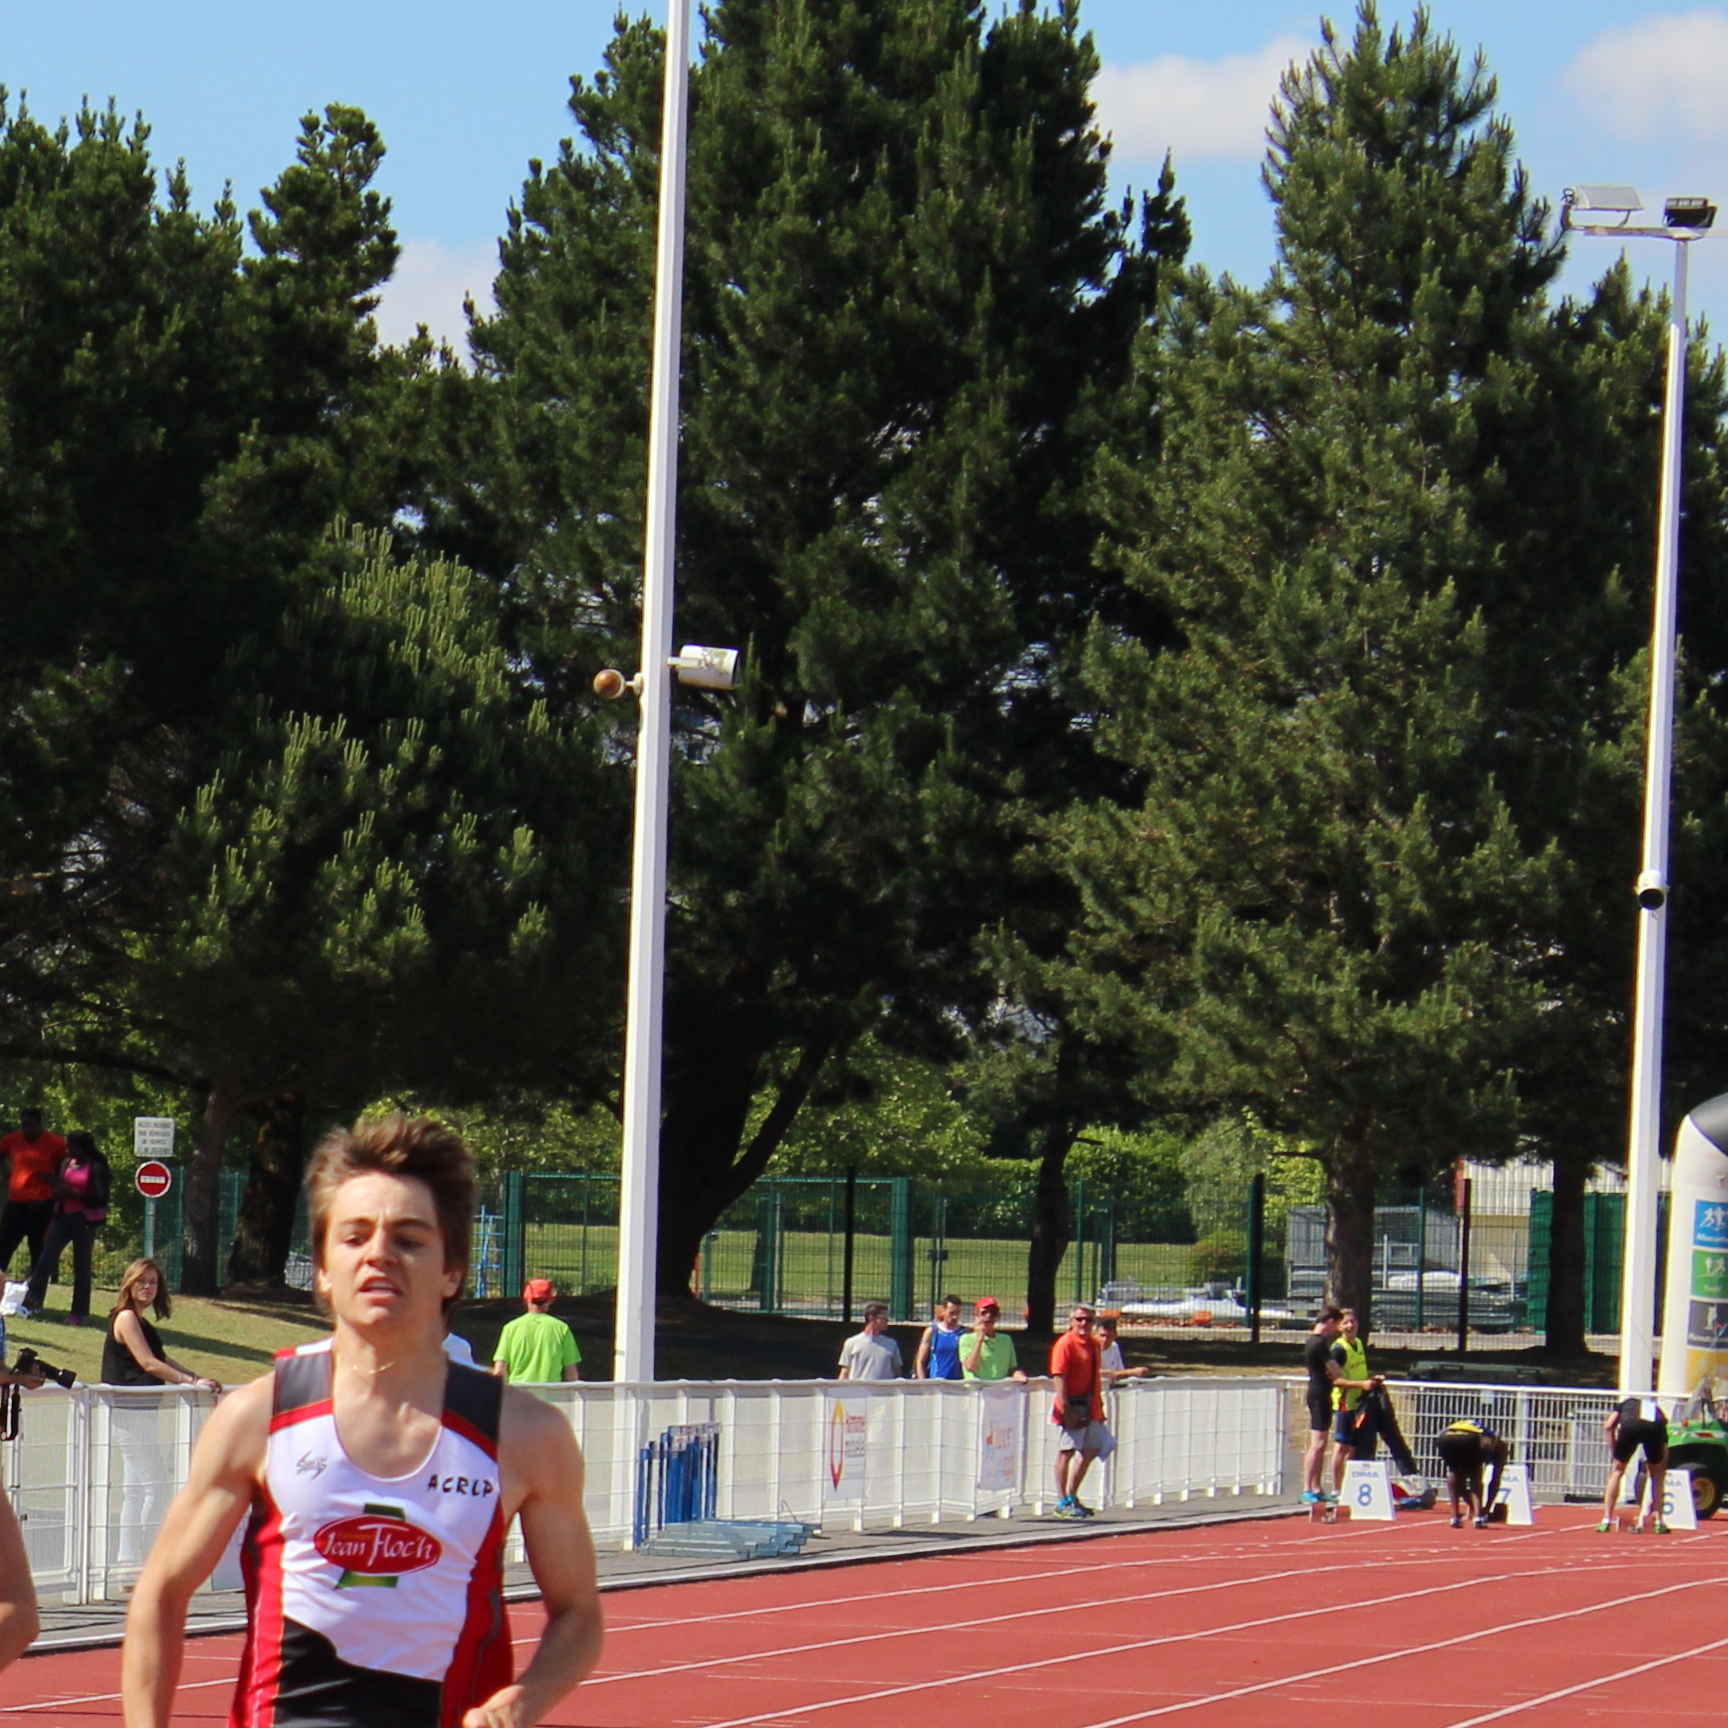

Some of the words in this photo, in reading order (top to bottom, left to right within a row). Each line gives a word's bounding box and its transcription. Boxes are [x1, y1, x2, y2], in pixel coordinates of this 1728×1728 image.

[427, 1473, 494, 1499] ACRLP
[1357, 1483, 1373, 1507] 8
[1498, 1487, 1513, 1504] 7
[1662, 1491, 1676, 1516] 6
[323, 1531, 366, 1557] Jean
[357, 1522, 434, 1568] Floc'h
